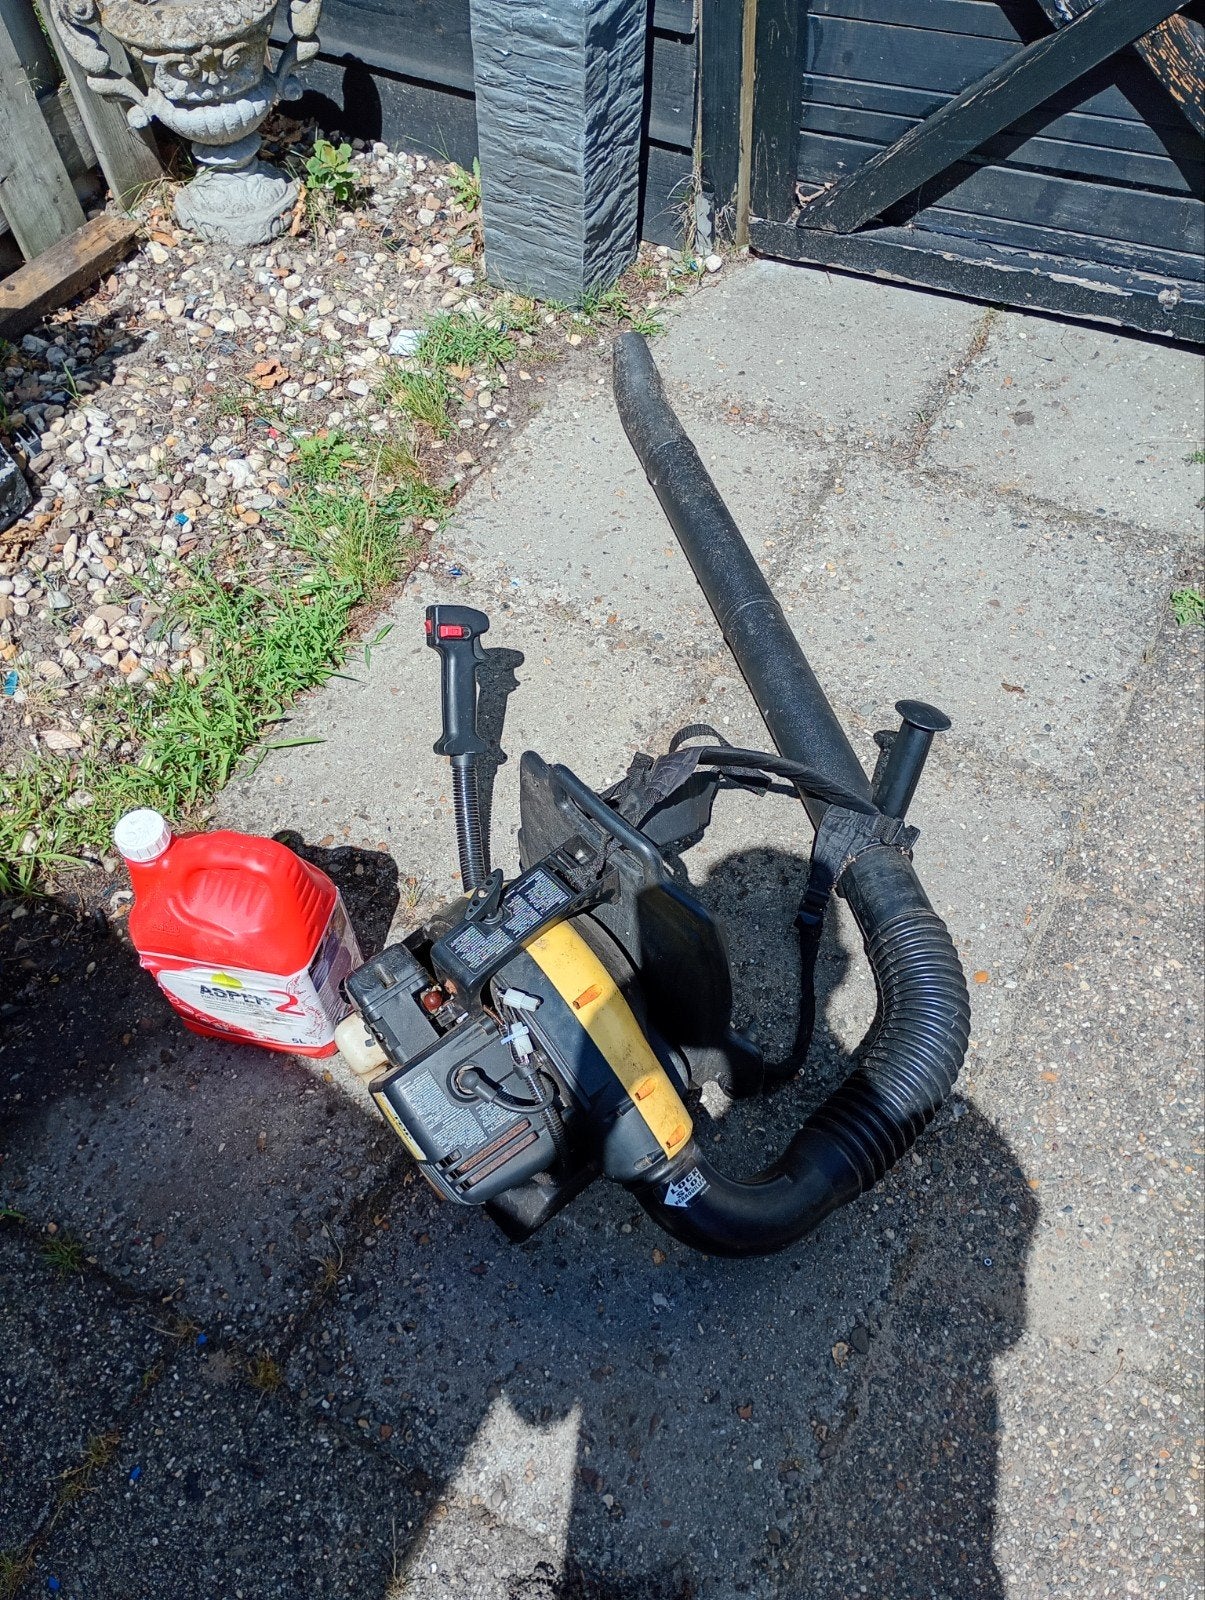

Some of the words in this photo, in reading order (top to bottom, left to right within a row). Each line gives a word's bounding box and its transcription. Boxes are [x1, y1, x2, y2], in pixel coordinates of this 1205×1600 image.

[266, 990, 306, 1016] 2
[670, 1169, 699, 1195] LOCK
[676, 1174, 703, 1198] SLOT
